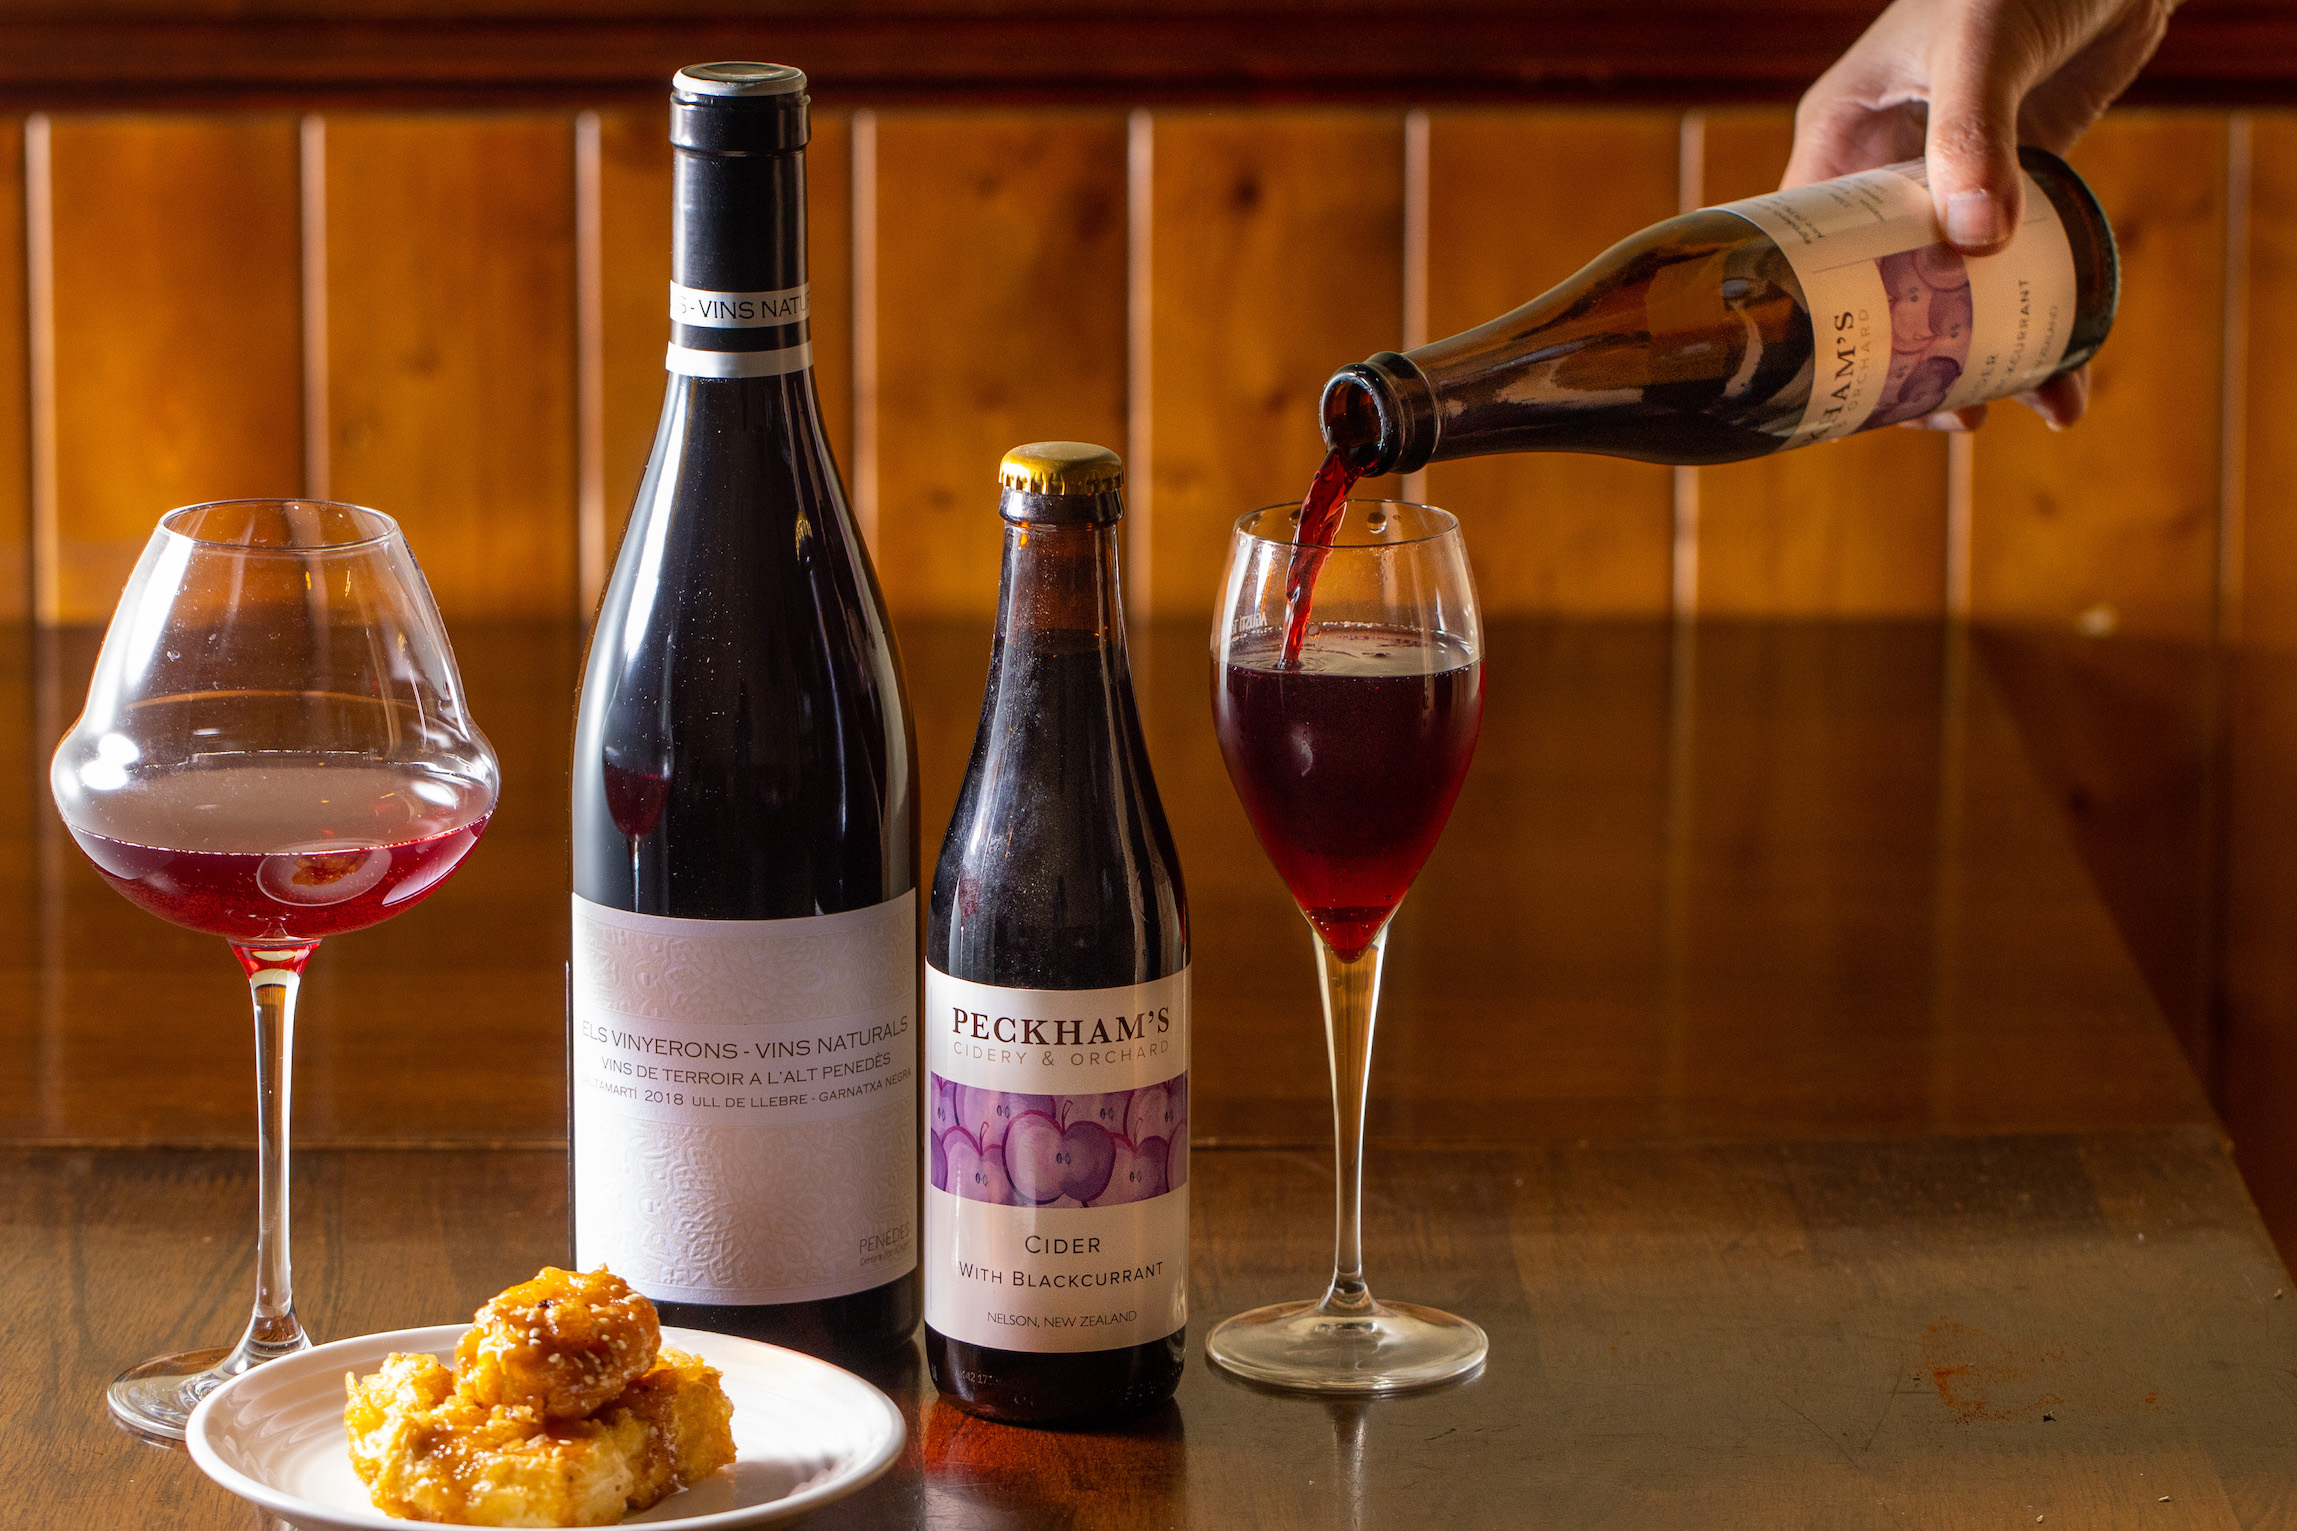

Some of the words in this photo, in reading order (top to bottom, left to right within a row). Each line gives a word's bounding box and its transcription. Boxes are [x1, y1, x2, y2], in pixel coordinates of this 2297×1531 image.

[698, 299, 755, 319] VINS
[582, 1020, 608, 1043] ELS
[611, 1030, 738, 1060] VINYERONS
[755, 1039, 811, 1059] VINS
[817, 1015, 909, 1054] NATURALS
[952, 1006, 1170, 1046] PECKHAM'S
[601, 1056, 633, 1076] VINS
[637, 1064, 660, 1081] DE
[662, 1068, 744, 1086] TERROIR
[749, 1072, 762, 1085] A
[767, 1067, 818, 1085] L'ALT
[822, 1051, 891, 1080] PENEDÈS
[953, 1041, 1028, 1066] CIDERY
[1041, 1051, 1055, 1066] &
[1070, 1040, 1170, 1066] ORCHARD
[644, 1089, 684, 1106] 2018
[692, 1096, 721, 1108] ULL
[725, 1096, 746, 1108] DE
[750, 1093, 809, 1108] LLEBRE
[818, 1079, 883, 1102] GARNATXA
[885, 1066, 912, 1087] NEGRA
[987, 1311, 1040, 1329] NELSON,
[1044, 1316, 1077, 1328] NEW
[1080, 1310, 1138, 1328] ZEALAND
